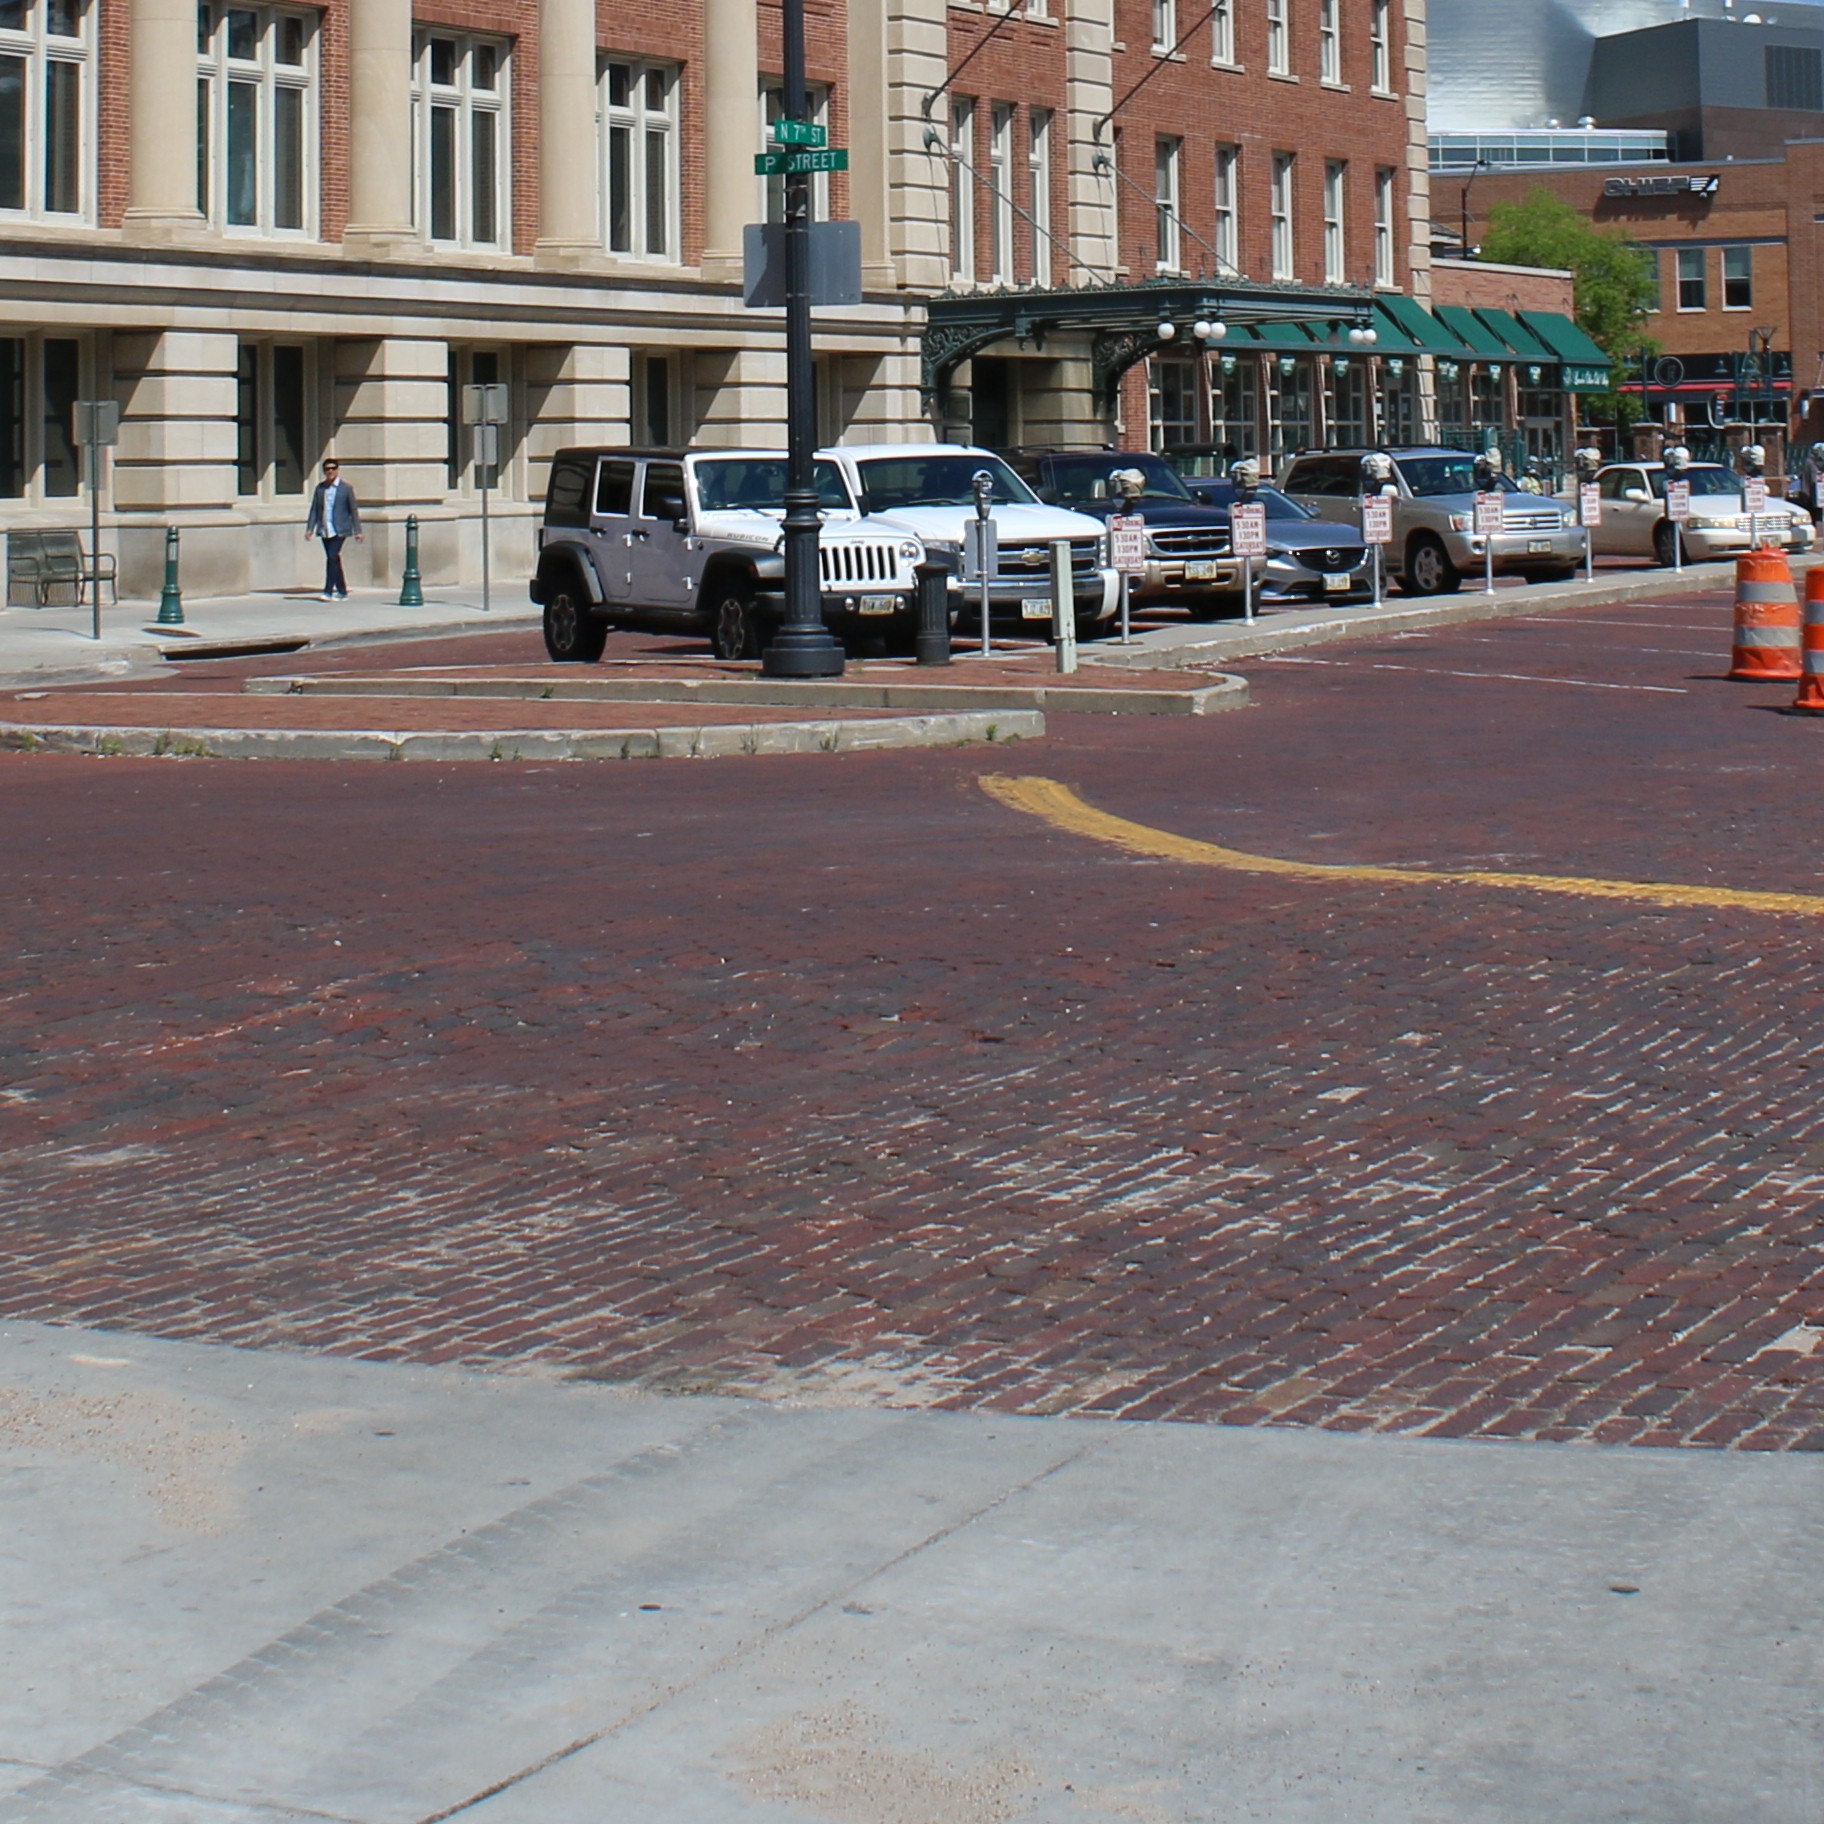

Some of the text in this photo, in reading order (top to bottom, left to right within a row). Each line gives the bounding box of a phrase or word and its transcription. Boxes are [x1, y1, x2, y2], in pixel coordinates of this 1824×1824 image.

[780, 125, 822, 143] N 7TH ST
[765, 152, 837, 171] P STREET
[727, 532, 769, 542] RUBICON
